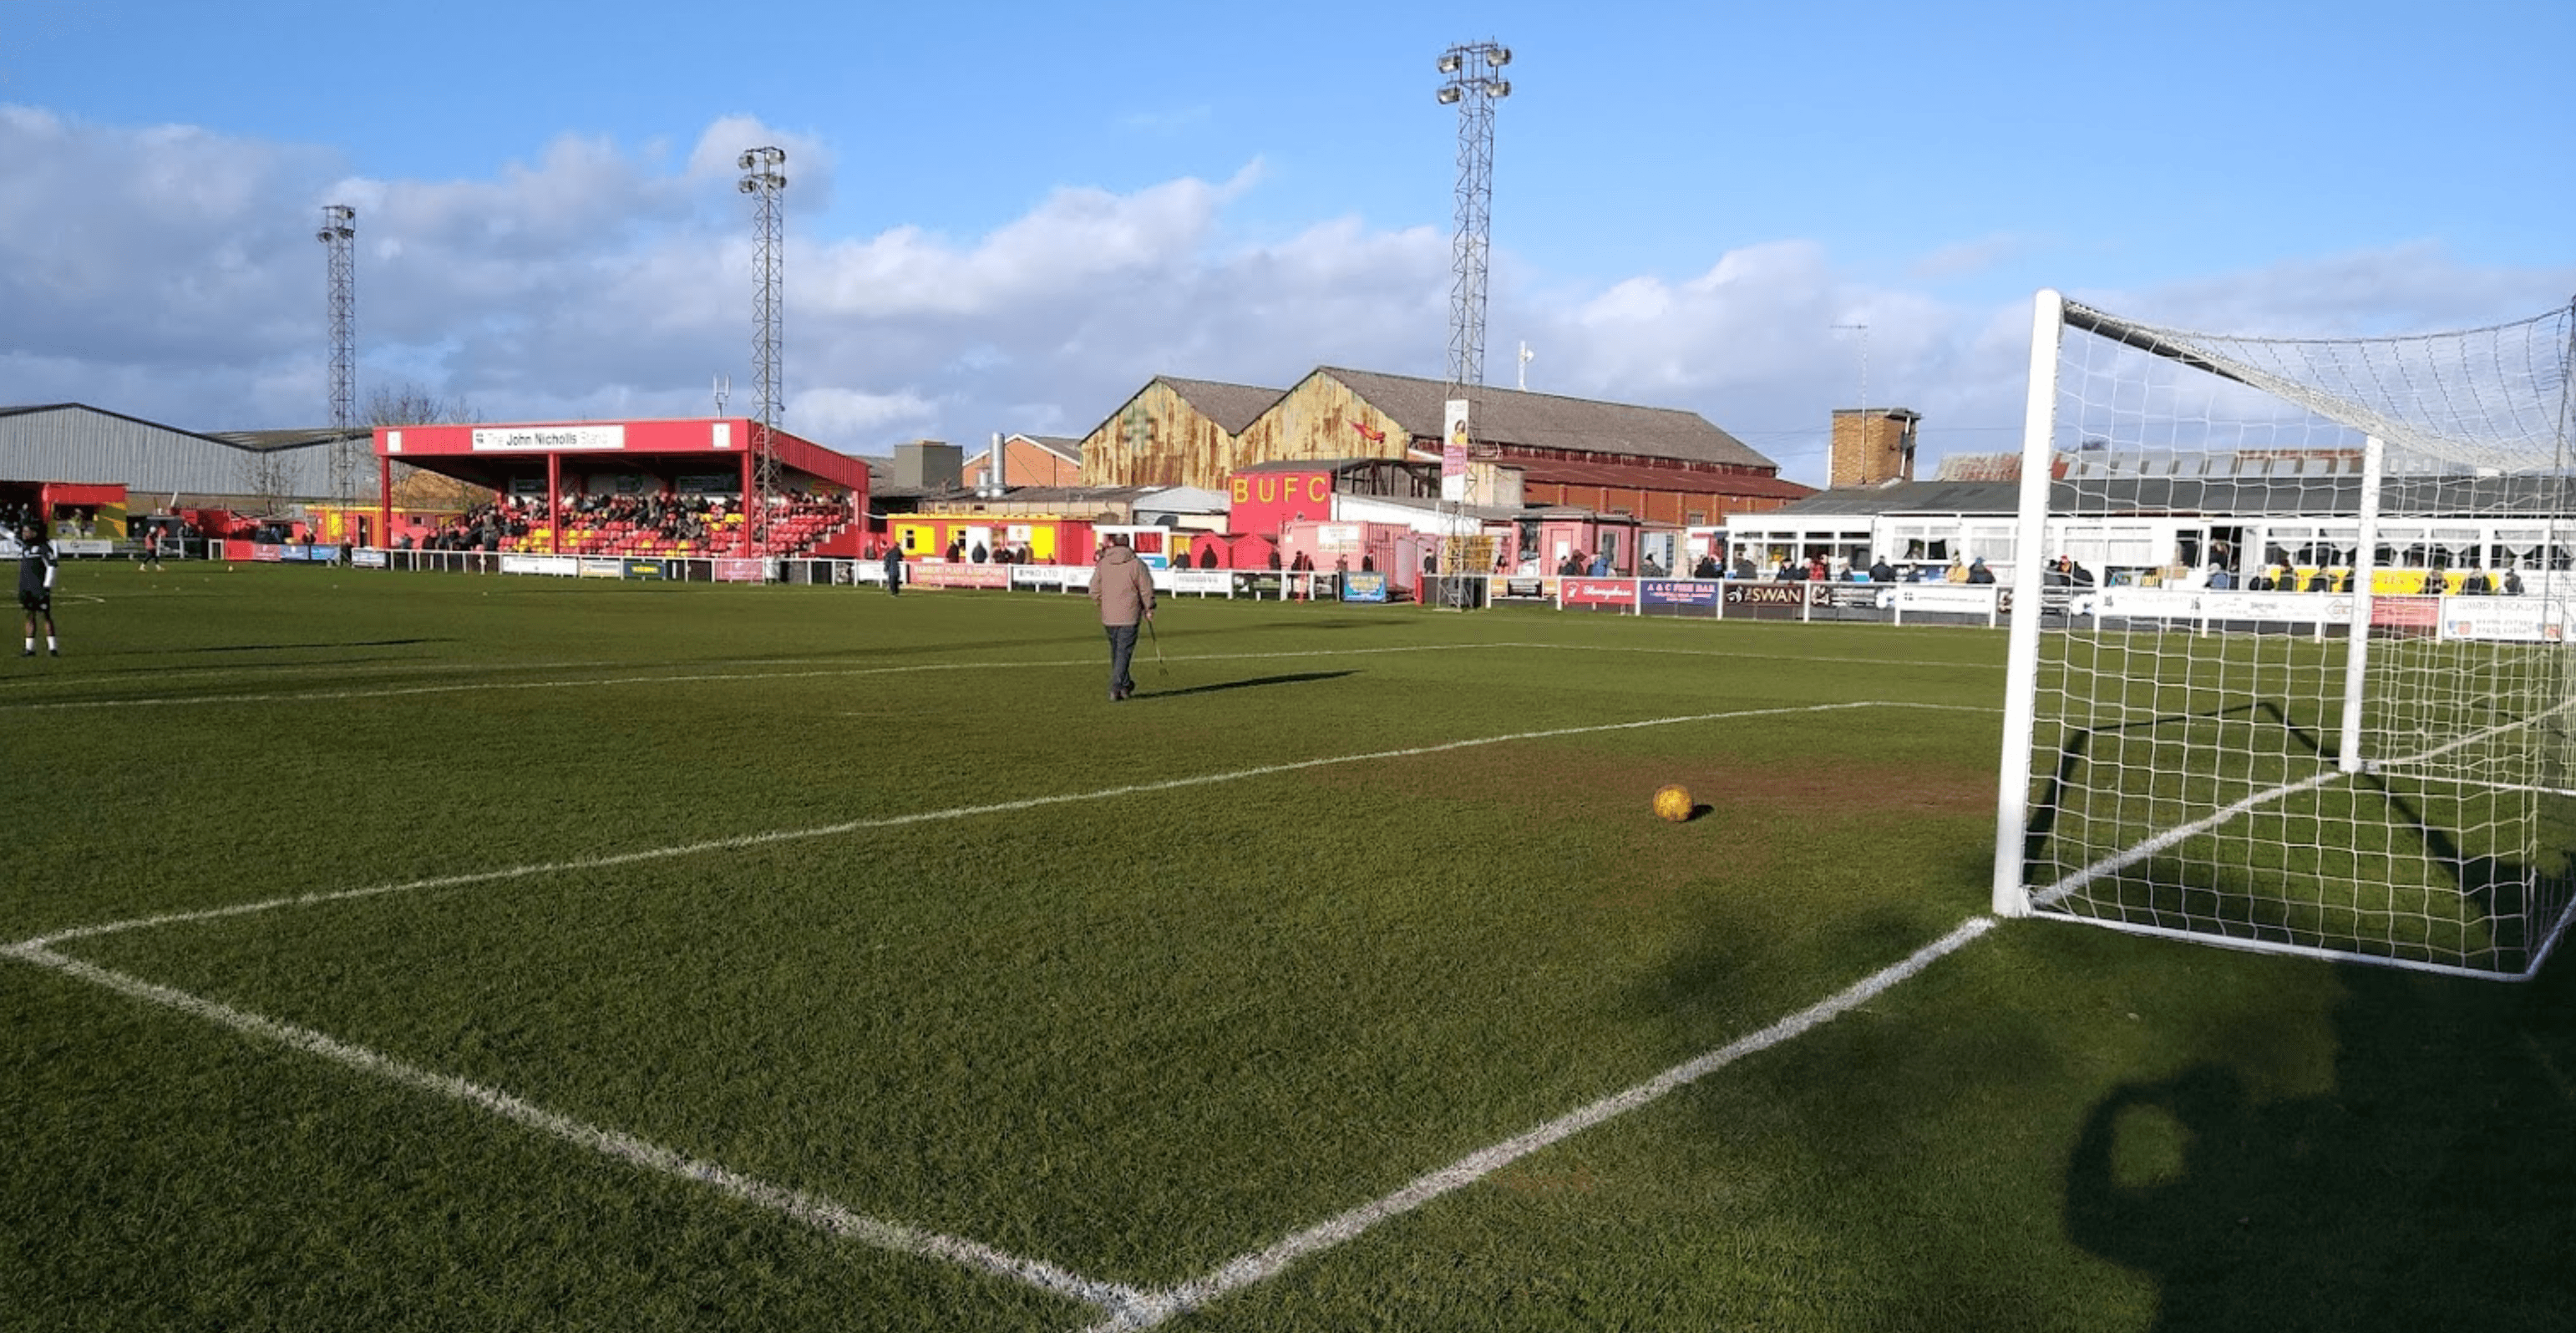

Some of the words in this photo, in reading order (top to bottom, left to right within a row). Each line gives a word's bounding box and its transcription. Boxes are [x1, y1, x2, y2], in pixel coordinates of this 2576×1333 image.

[506, 433, 532, 446] John
[534, 432, 578, 446] Nicholls
[1752, 588, 1802, 602] SWAN
